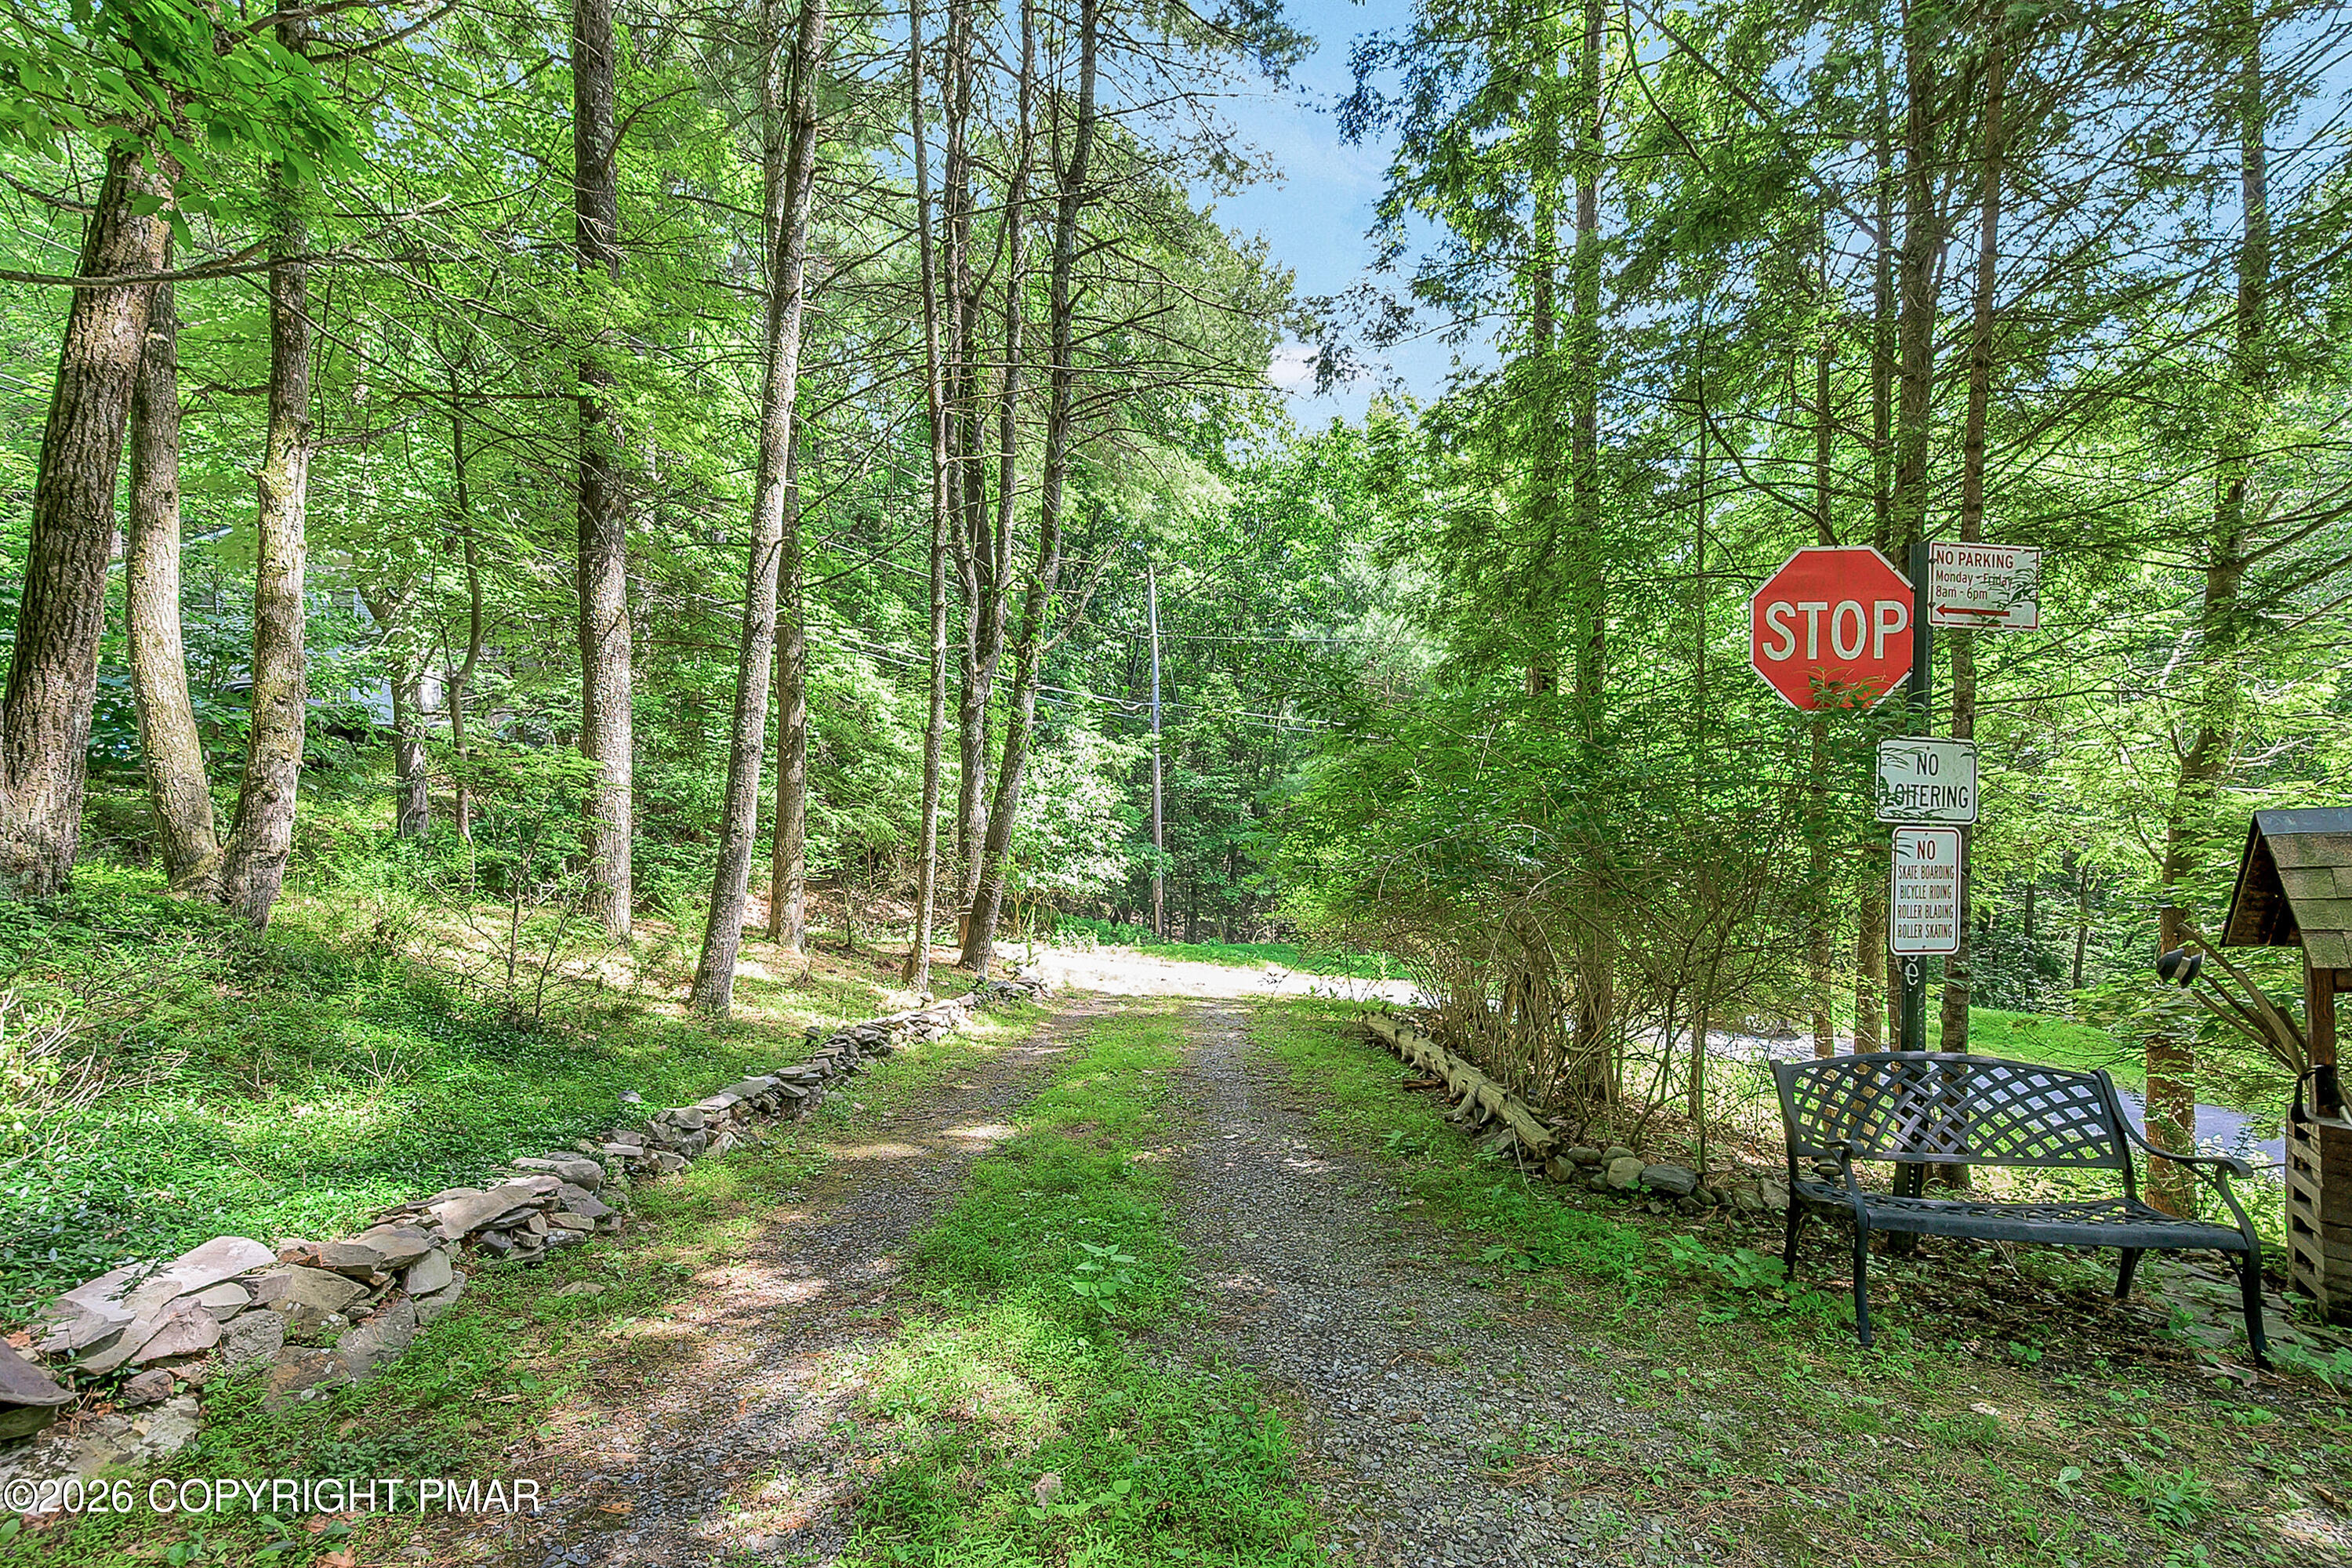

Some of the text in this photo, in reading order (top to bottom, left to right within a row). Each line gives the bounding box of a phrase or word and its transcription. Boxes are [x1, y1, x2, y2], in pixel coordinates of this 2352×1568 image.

[1936, 550, 2014, 569] NO PARKING
[1936, 569, 1973, 586] Monday
[1936, 586, 1957, 598] 8am
[1966, 587, 1988, 601] 6pm
[1762, 600, 1909, 662] STOP
[1917, 753, 1939, 776] NO
[1917, 840, 1936, 860] NO
[1898, 865, 1955, 880] SKATE BOARDING
[1900, 884, 1952, 899] BICYCLE RIDING
[1897, 904, 1954, 919] ROLLER BLADING
[1897, 924, 1953, 938] ROLLER SKATING
